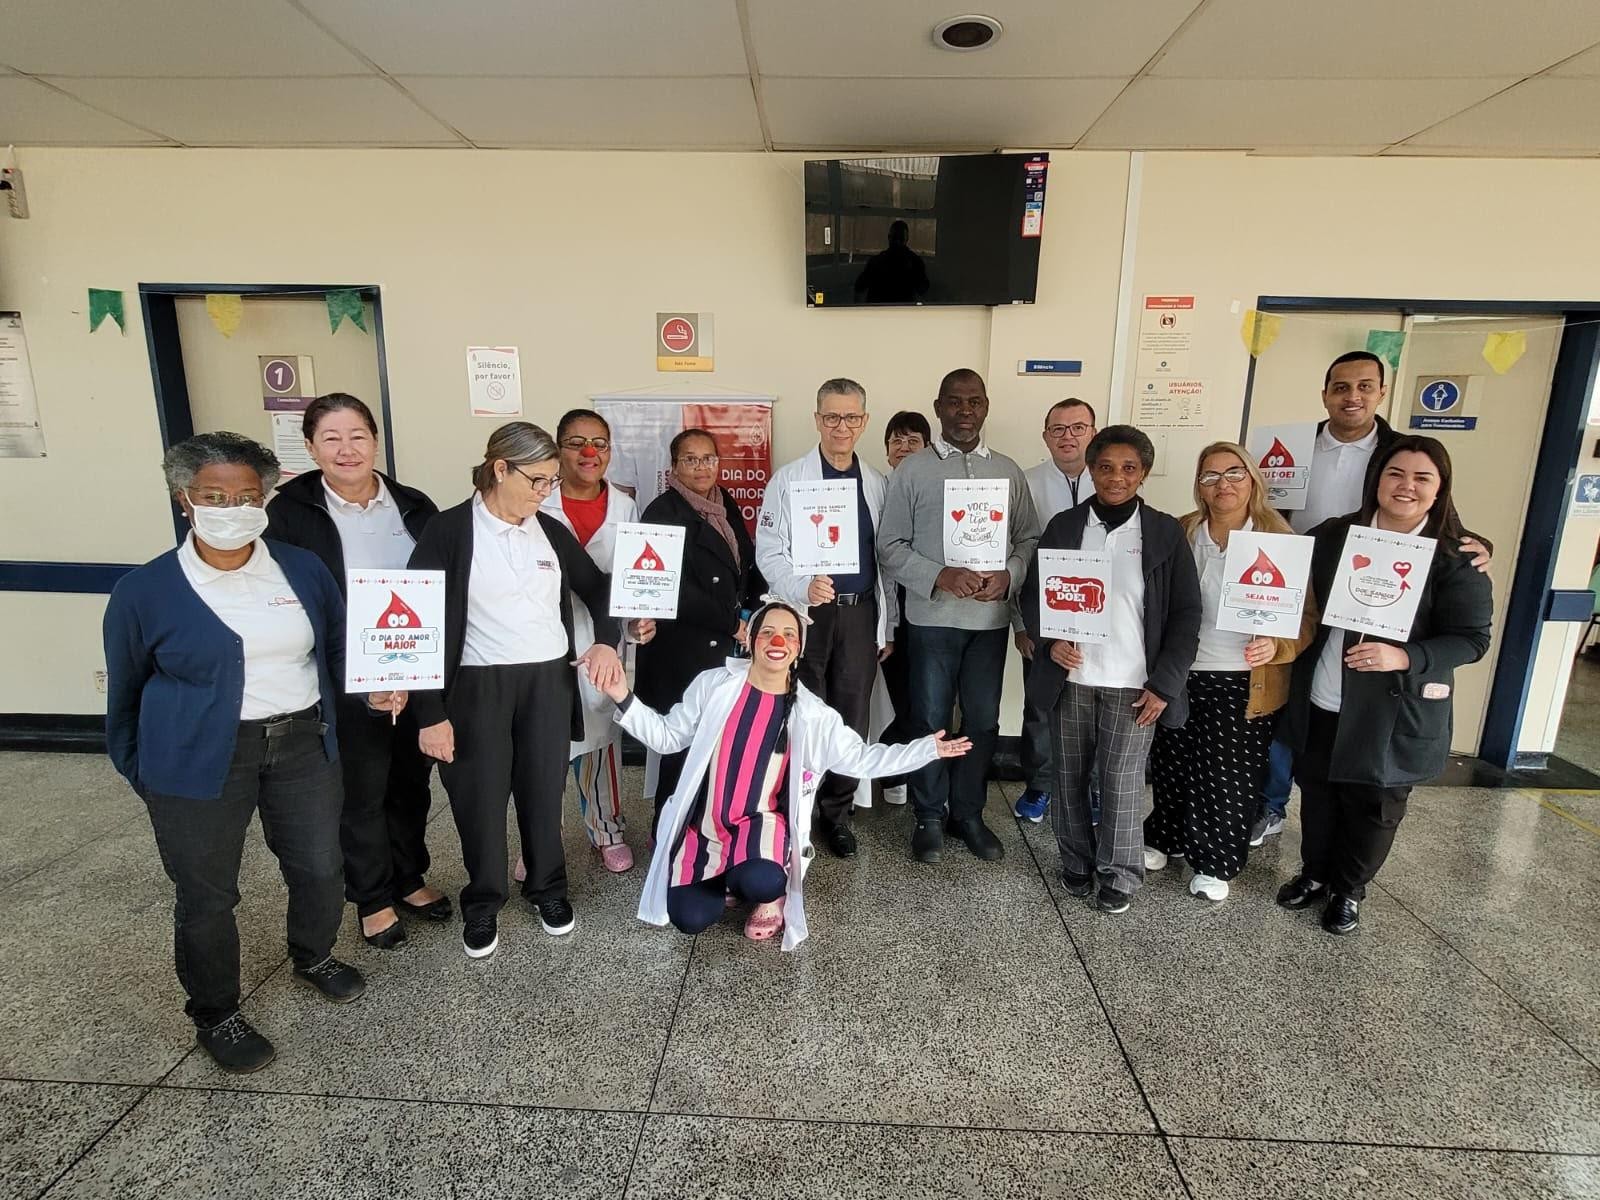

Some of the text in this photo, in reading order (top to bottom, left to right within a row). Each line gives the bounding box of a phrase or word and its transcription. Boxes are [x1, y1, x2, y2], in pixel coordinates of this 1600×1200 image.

[477, 361, 511, 369] Silêncio,
[274, 367, 283, 385] 1
[475, 374, 488, 382] por
[490, 372, 511, 380] favor
[721, 469, 766, 480] DIA DO
[728, 488, 765, 499] AMOR
[1046, 577, 1081, 592] #EU
[1056, 591, 1086, 602] DOEI
[408, 633, 430, 641] AMOR
[384, 640, 417, 650] MAIOR
